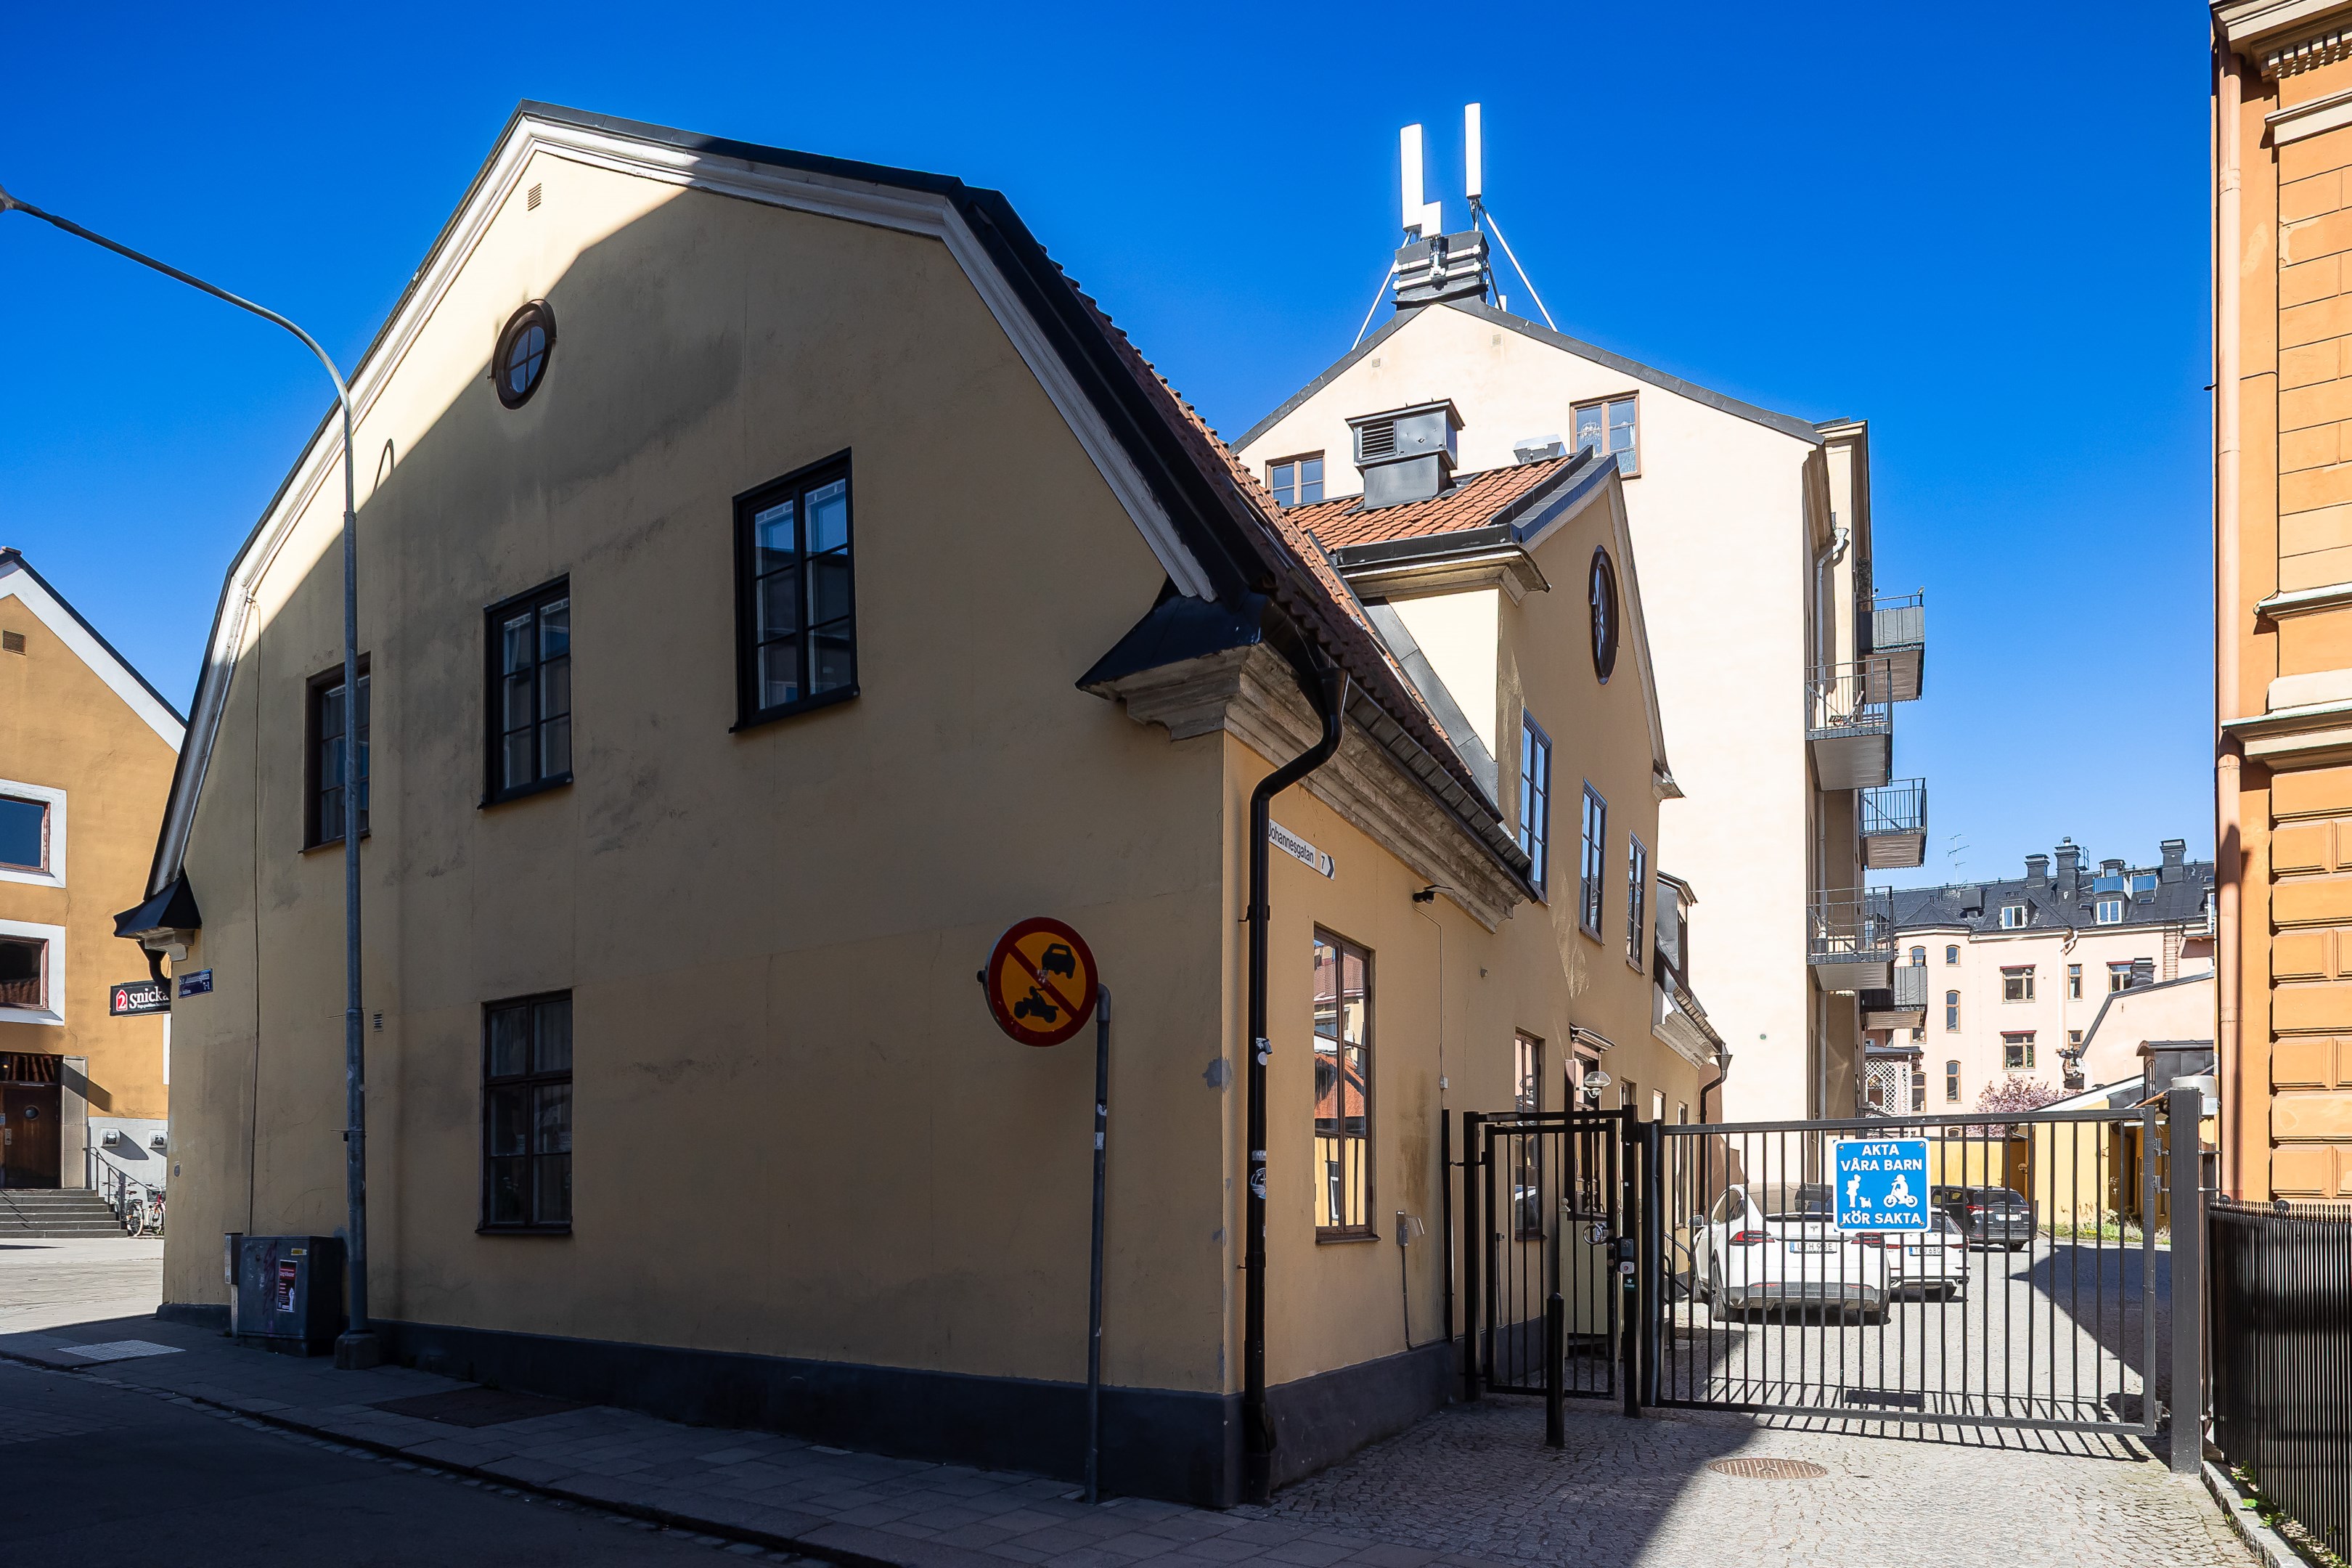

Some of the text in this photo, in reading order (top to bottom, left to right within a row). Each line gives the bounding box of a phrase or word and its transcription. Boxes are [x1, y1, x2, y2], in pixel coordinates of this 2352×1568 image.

[1268, 822, 1326, 870] Johannesgatan 7
[118, 995, 126, 1009] 2
[1861, 1143, 1900, 1156] AKTA
[1840, 1157, 1922, 1171] VÅRA BARN
[1842, 1210, 1921, 1225] KÖR SAKTA
